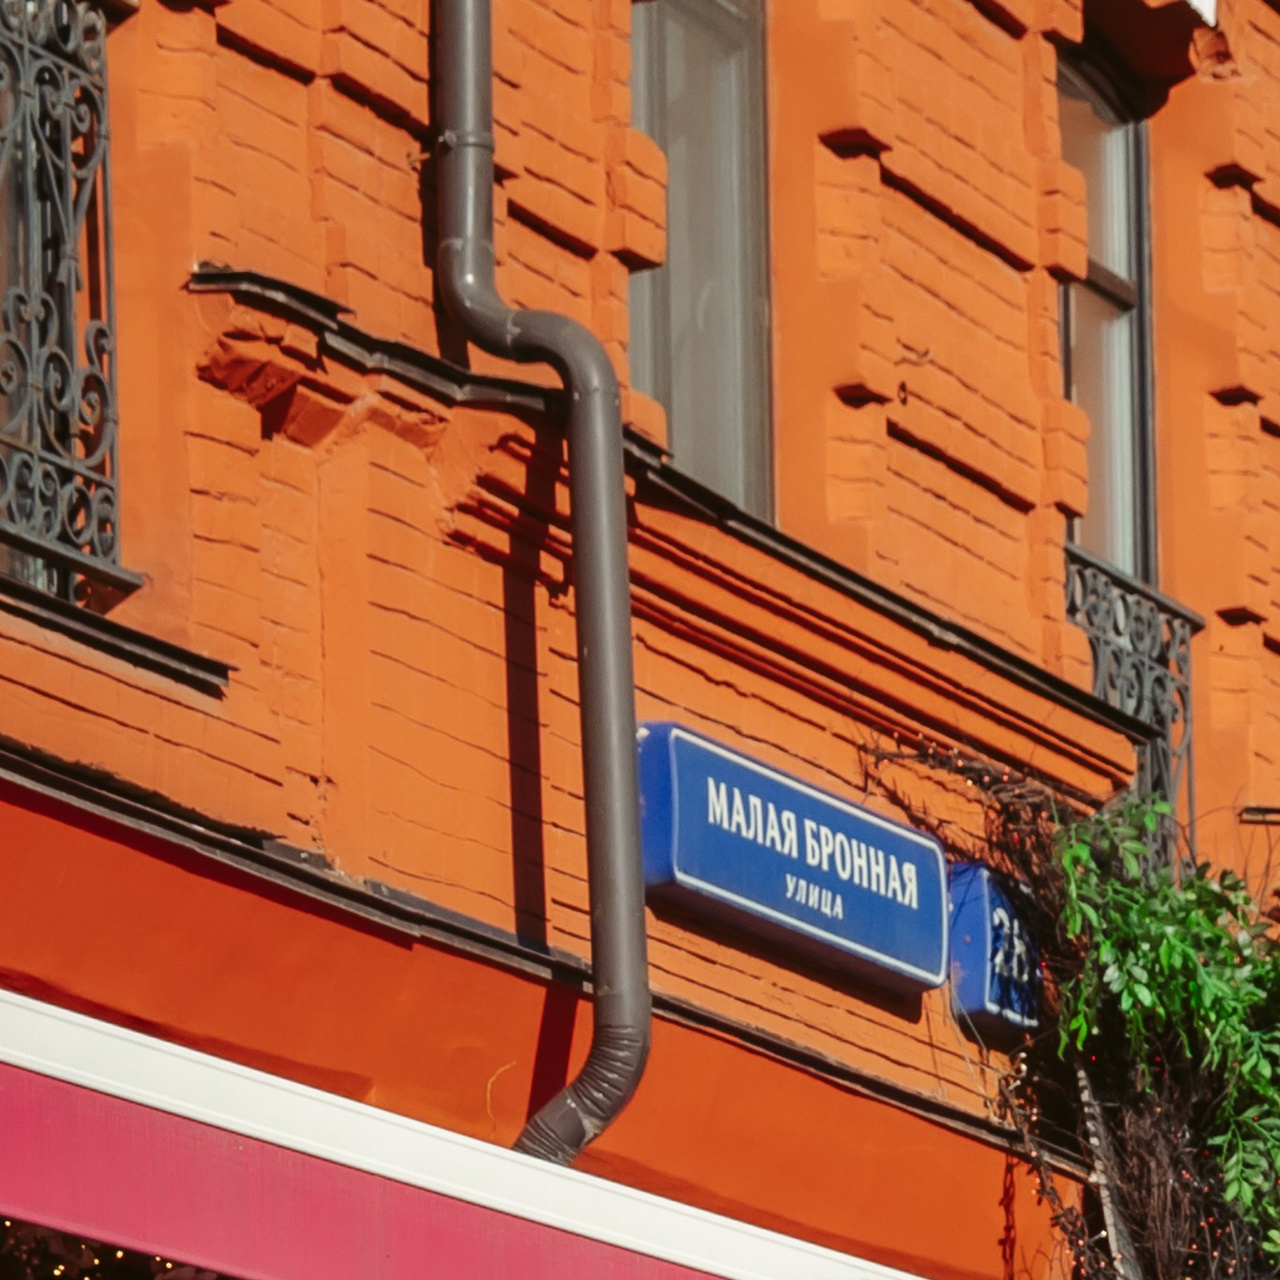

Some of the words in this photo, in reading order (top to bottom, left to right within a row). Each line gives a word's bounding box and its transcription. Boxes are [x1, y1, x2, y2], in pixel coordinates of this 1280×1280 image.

[706, 776, 798, 859] МАЛАЯ
[804, 818, 919, 910] БРОННАЯ
[785, 873, 844, 920] УЛИЦА
